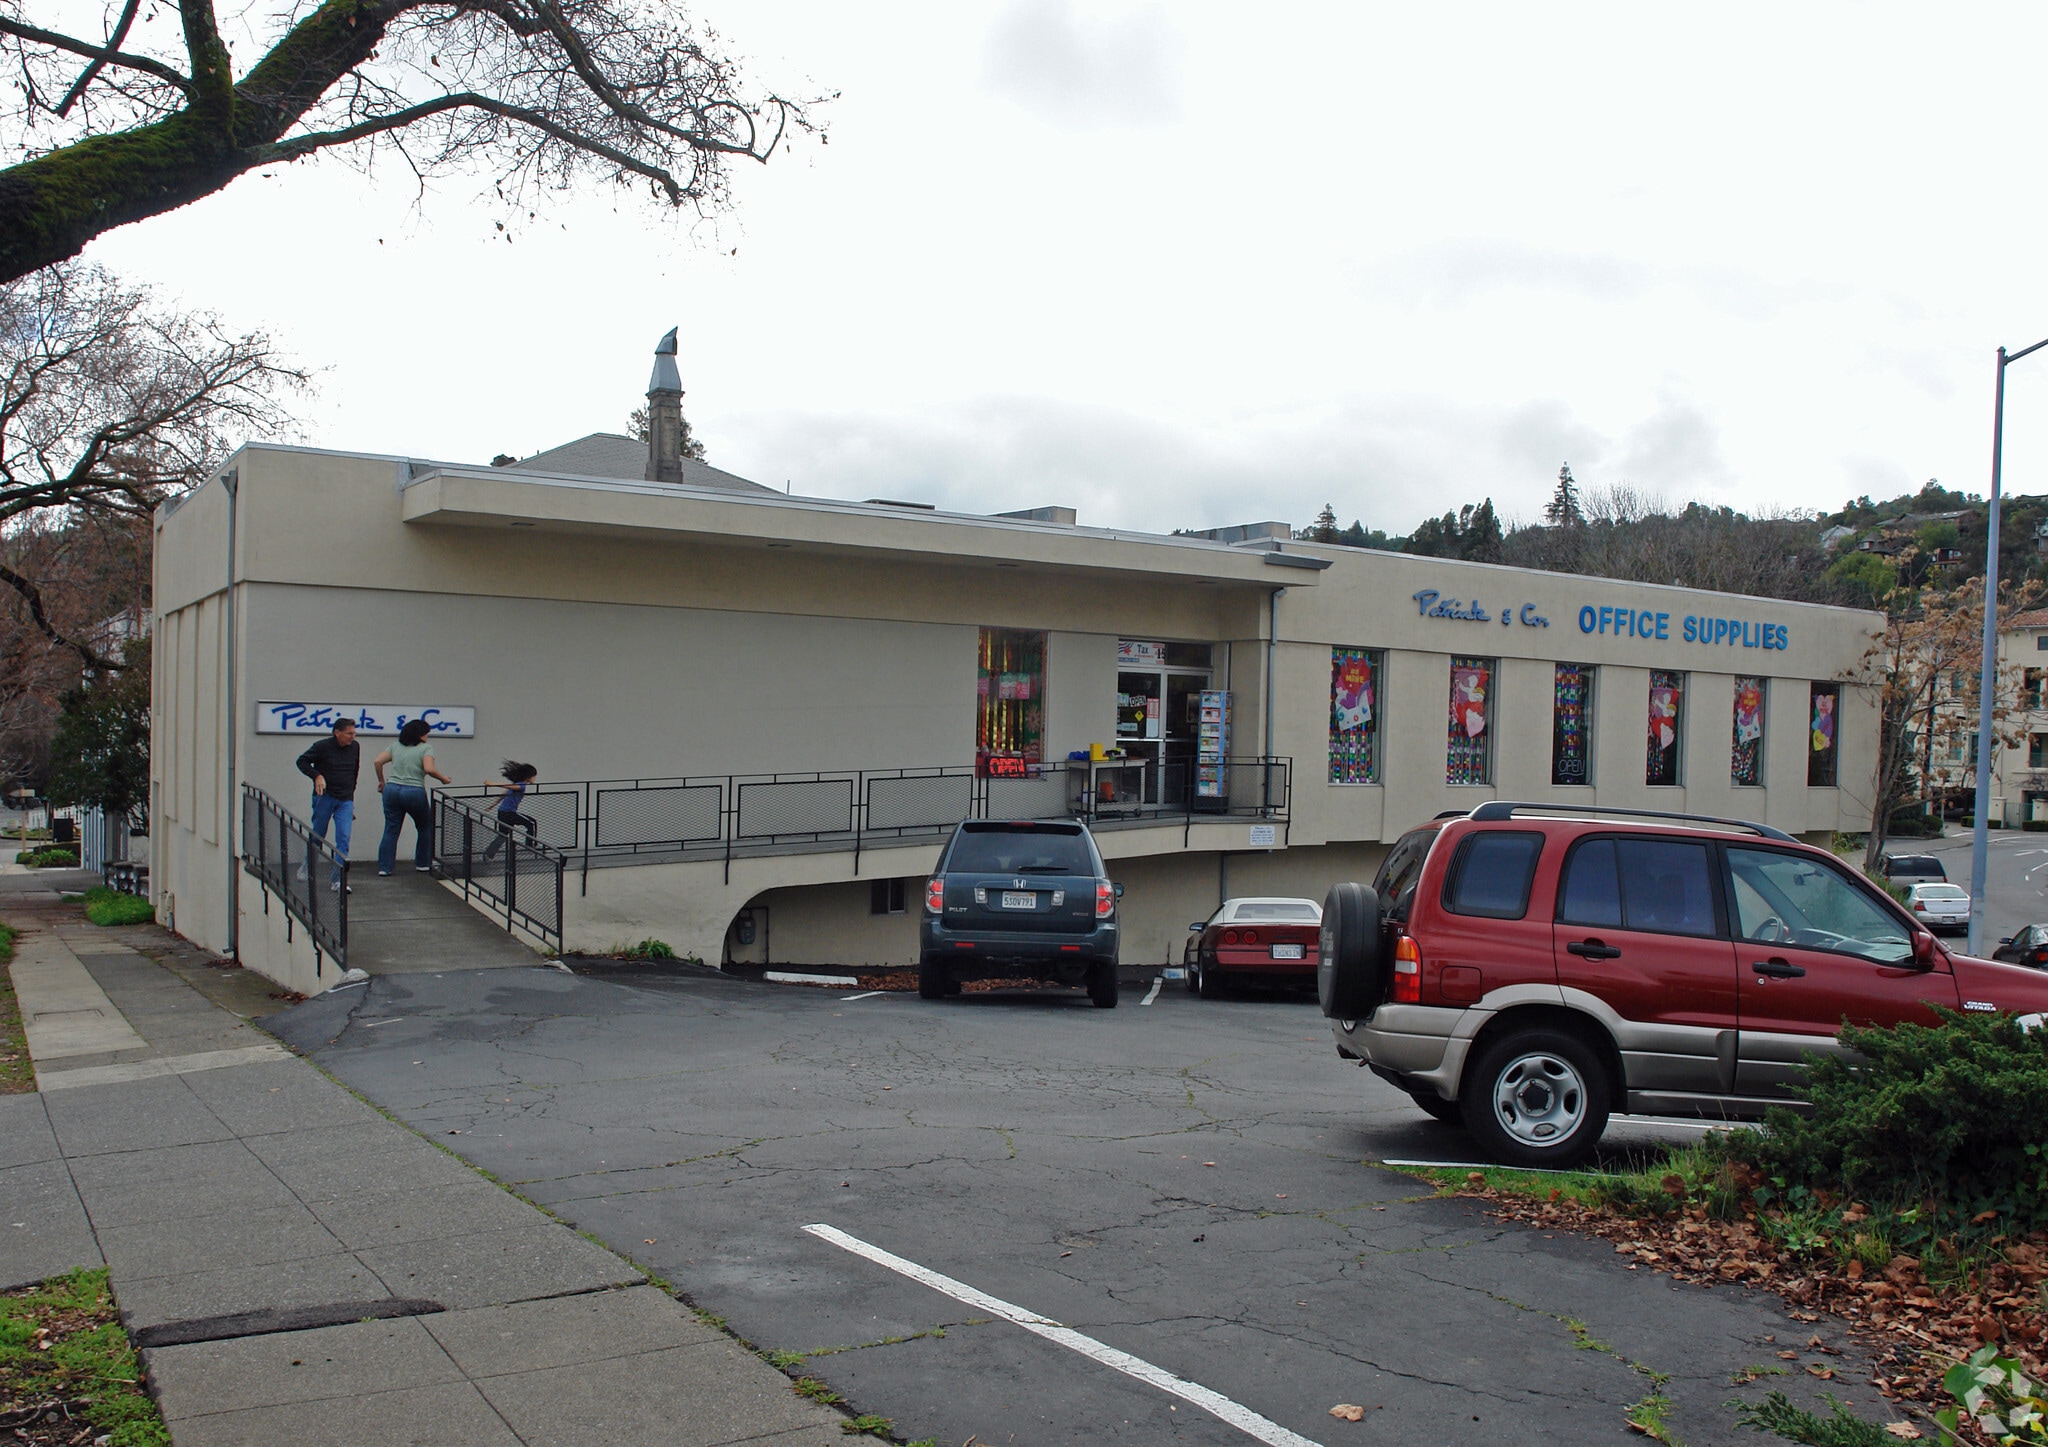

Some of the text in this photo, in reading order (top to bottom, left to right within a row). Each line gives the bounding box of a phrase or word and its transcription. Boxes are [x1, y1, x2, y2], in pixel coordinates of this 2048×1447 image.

[1412, 588, 1492, 622] Patrick
[1578, 605, 1789, 650] OFFICE SUPPLIES
[990, 757, 1025, 777] OPEN
[1558, 759, 1585, 773] OPEN
